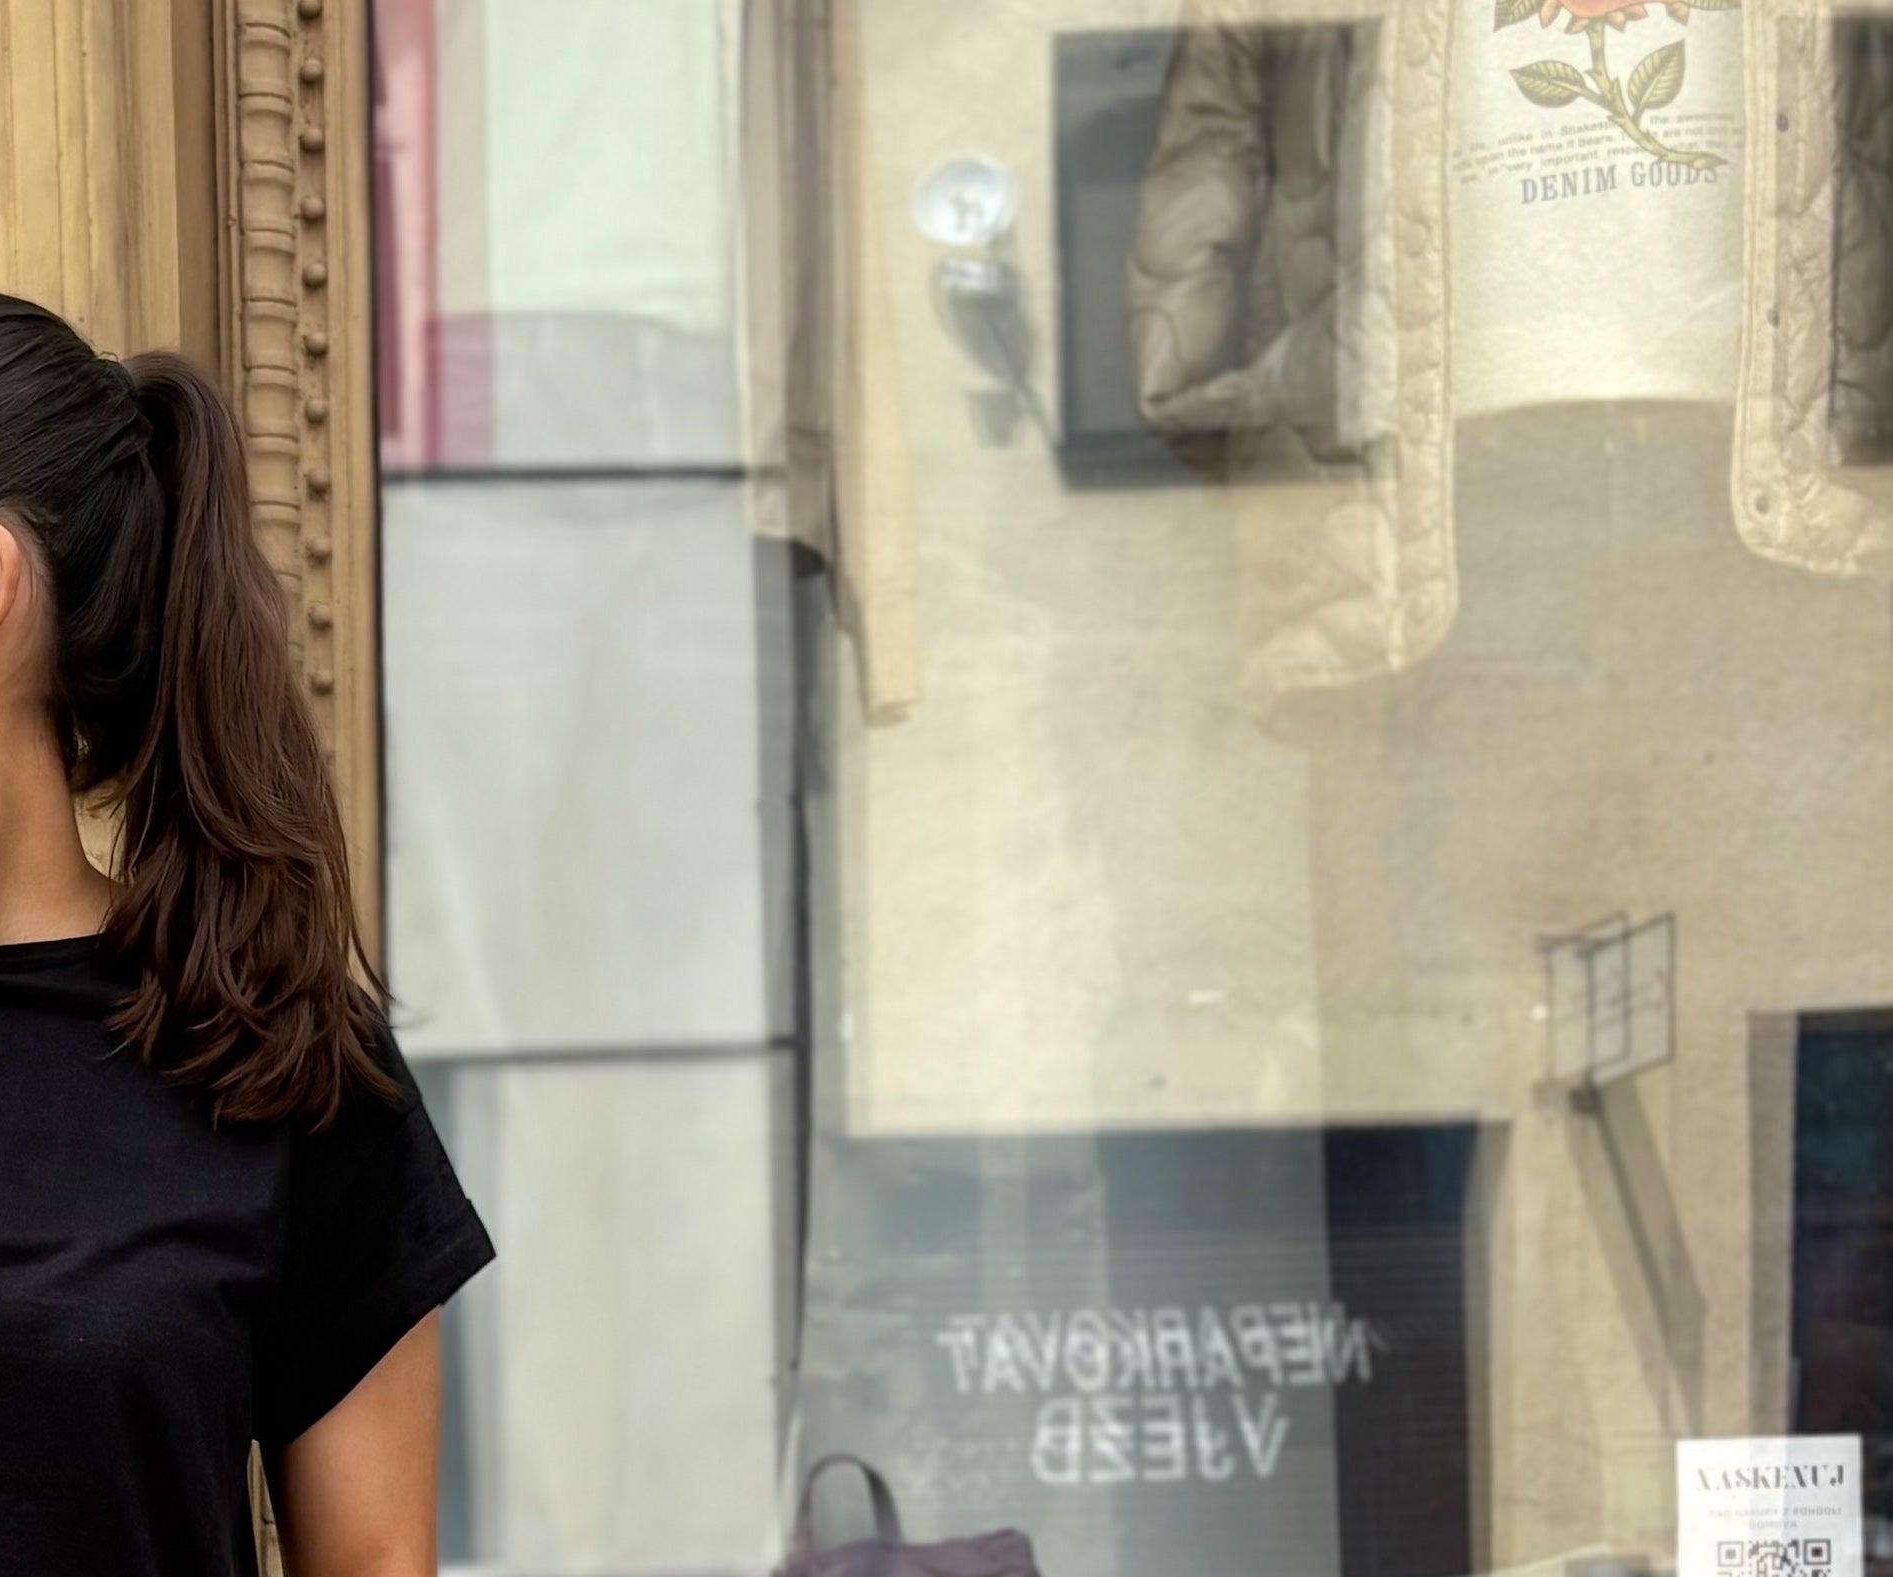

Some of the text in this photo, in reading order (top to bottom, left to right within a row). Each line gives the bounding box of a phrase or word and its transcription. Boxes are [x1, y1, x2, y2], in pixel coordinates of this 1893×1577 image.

[1521, 159, 1719, 205] DENIM GOODS
[1696, 1464, 1845, 1492] NASKENUJ
